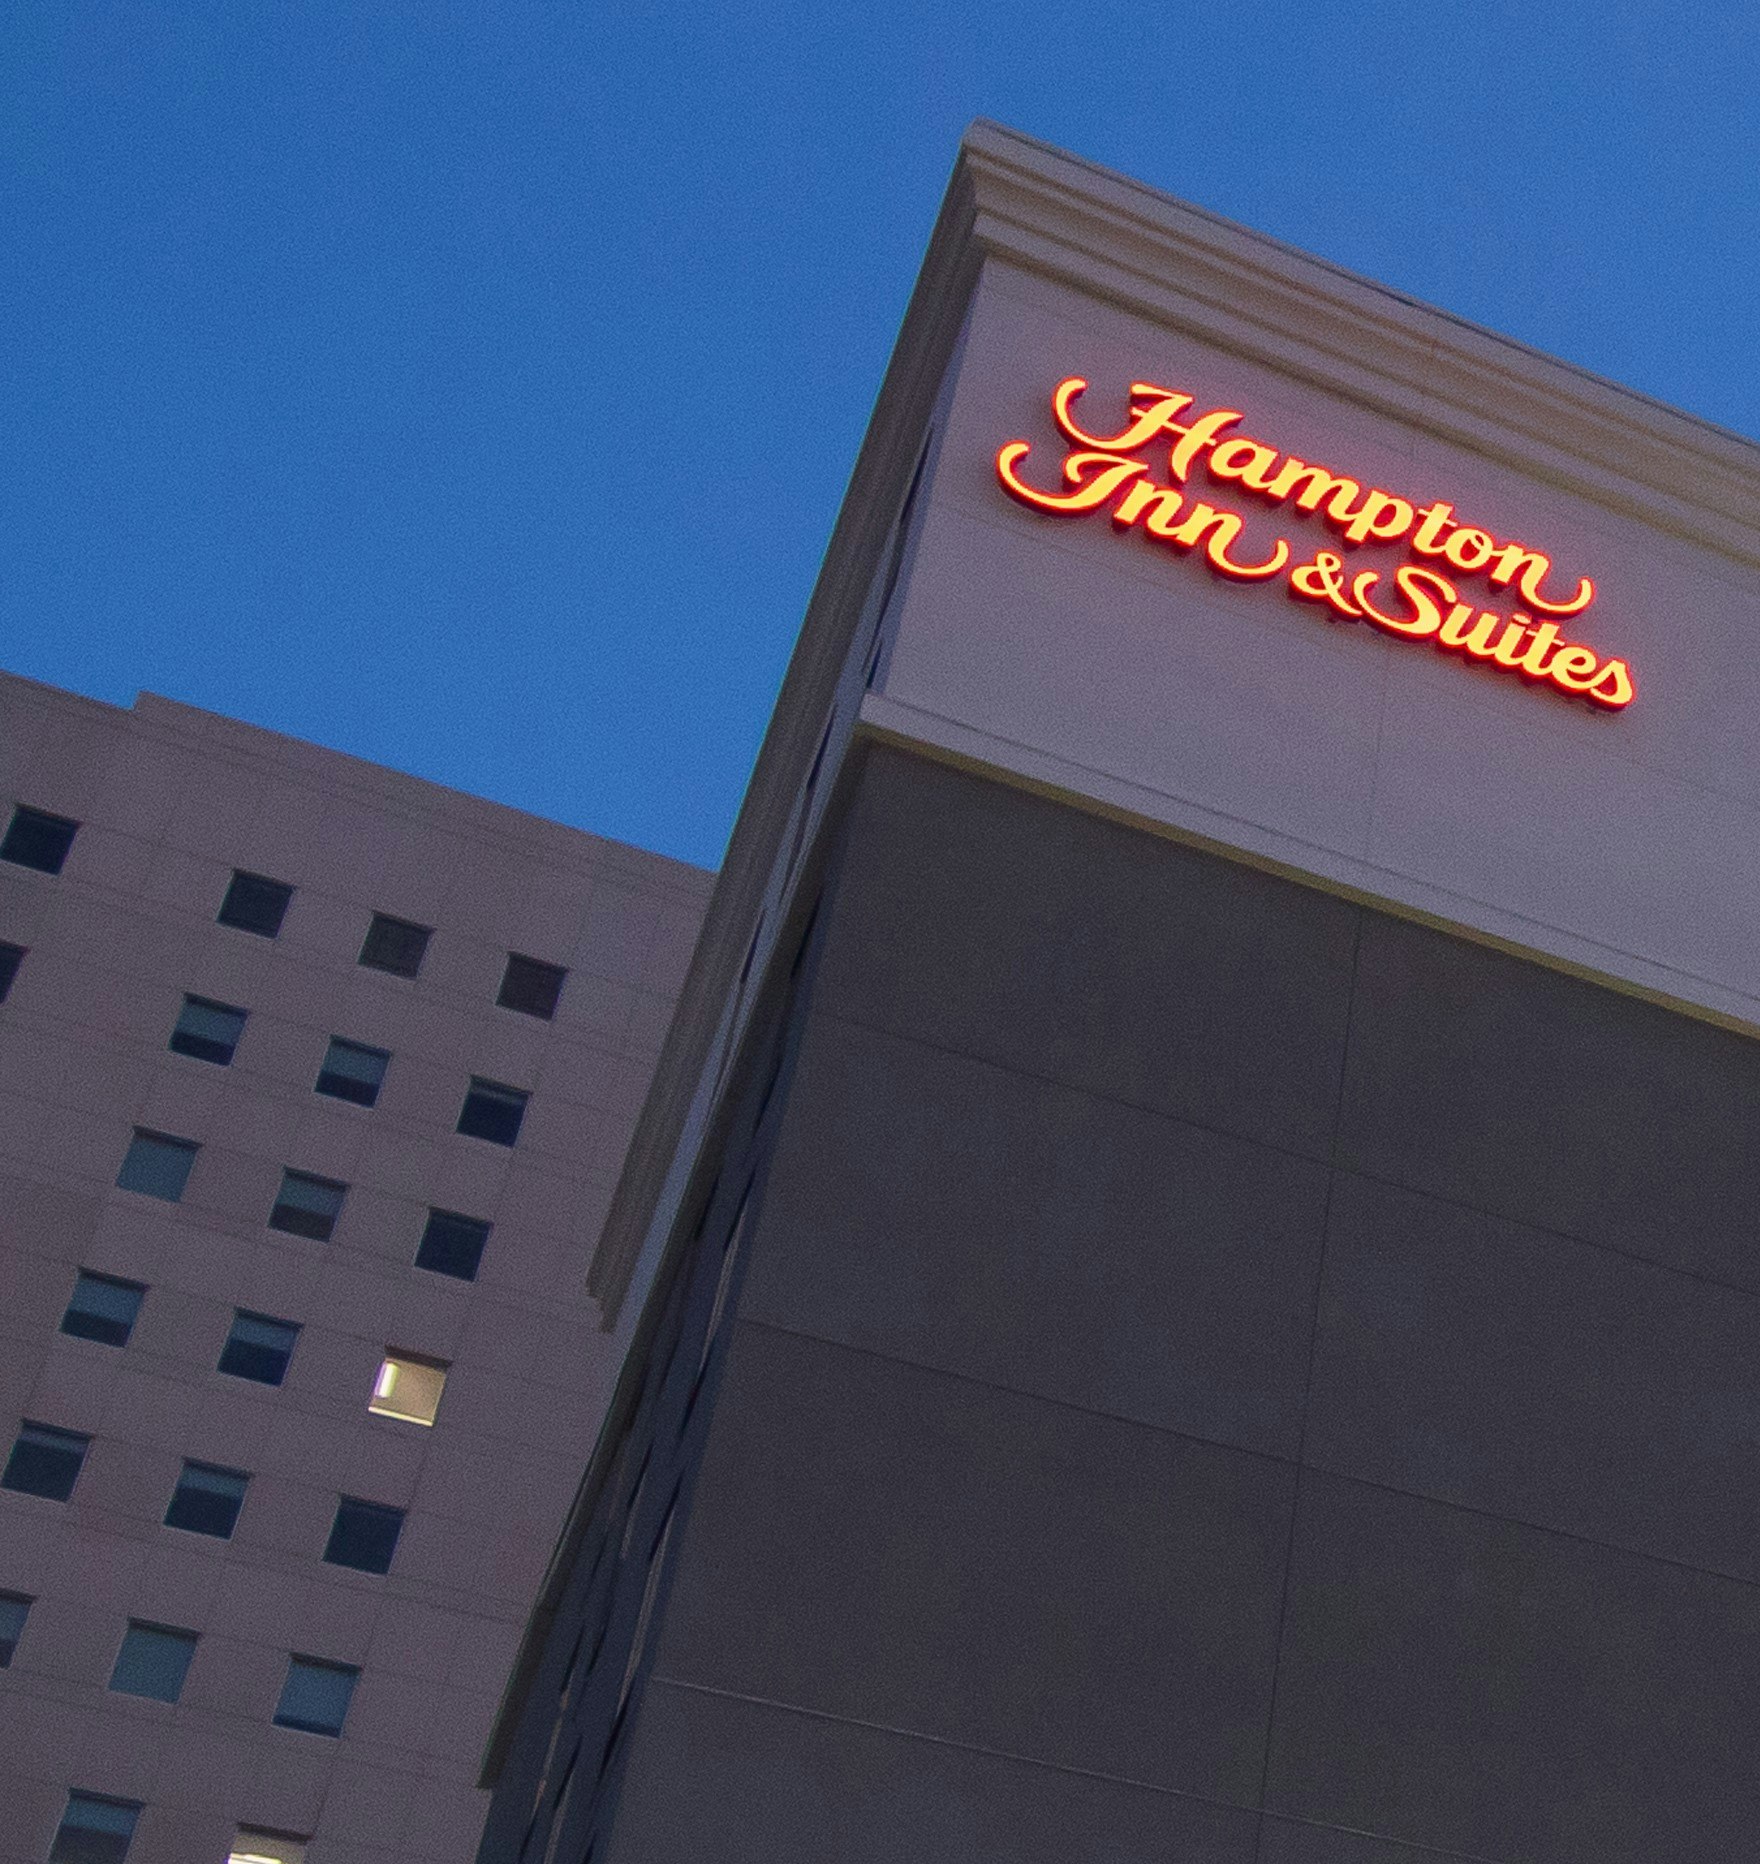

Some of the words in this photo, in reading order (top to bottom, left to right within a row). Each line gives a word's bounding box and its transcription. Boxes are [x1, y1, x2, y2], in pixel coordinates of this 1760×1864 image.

[996, 440, 1291, 580] Inn
[1289, 549, 1365, 618] &
[1352, 563, 1636, 708] Suites
[1053, 376, 1595, 615] Hampton
